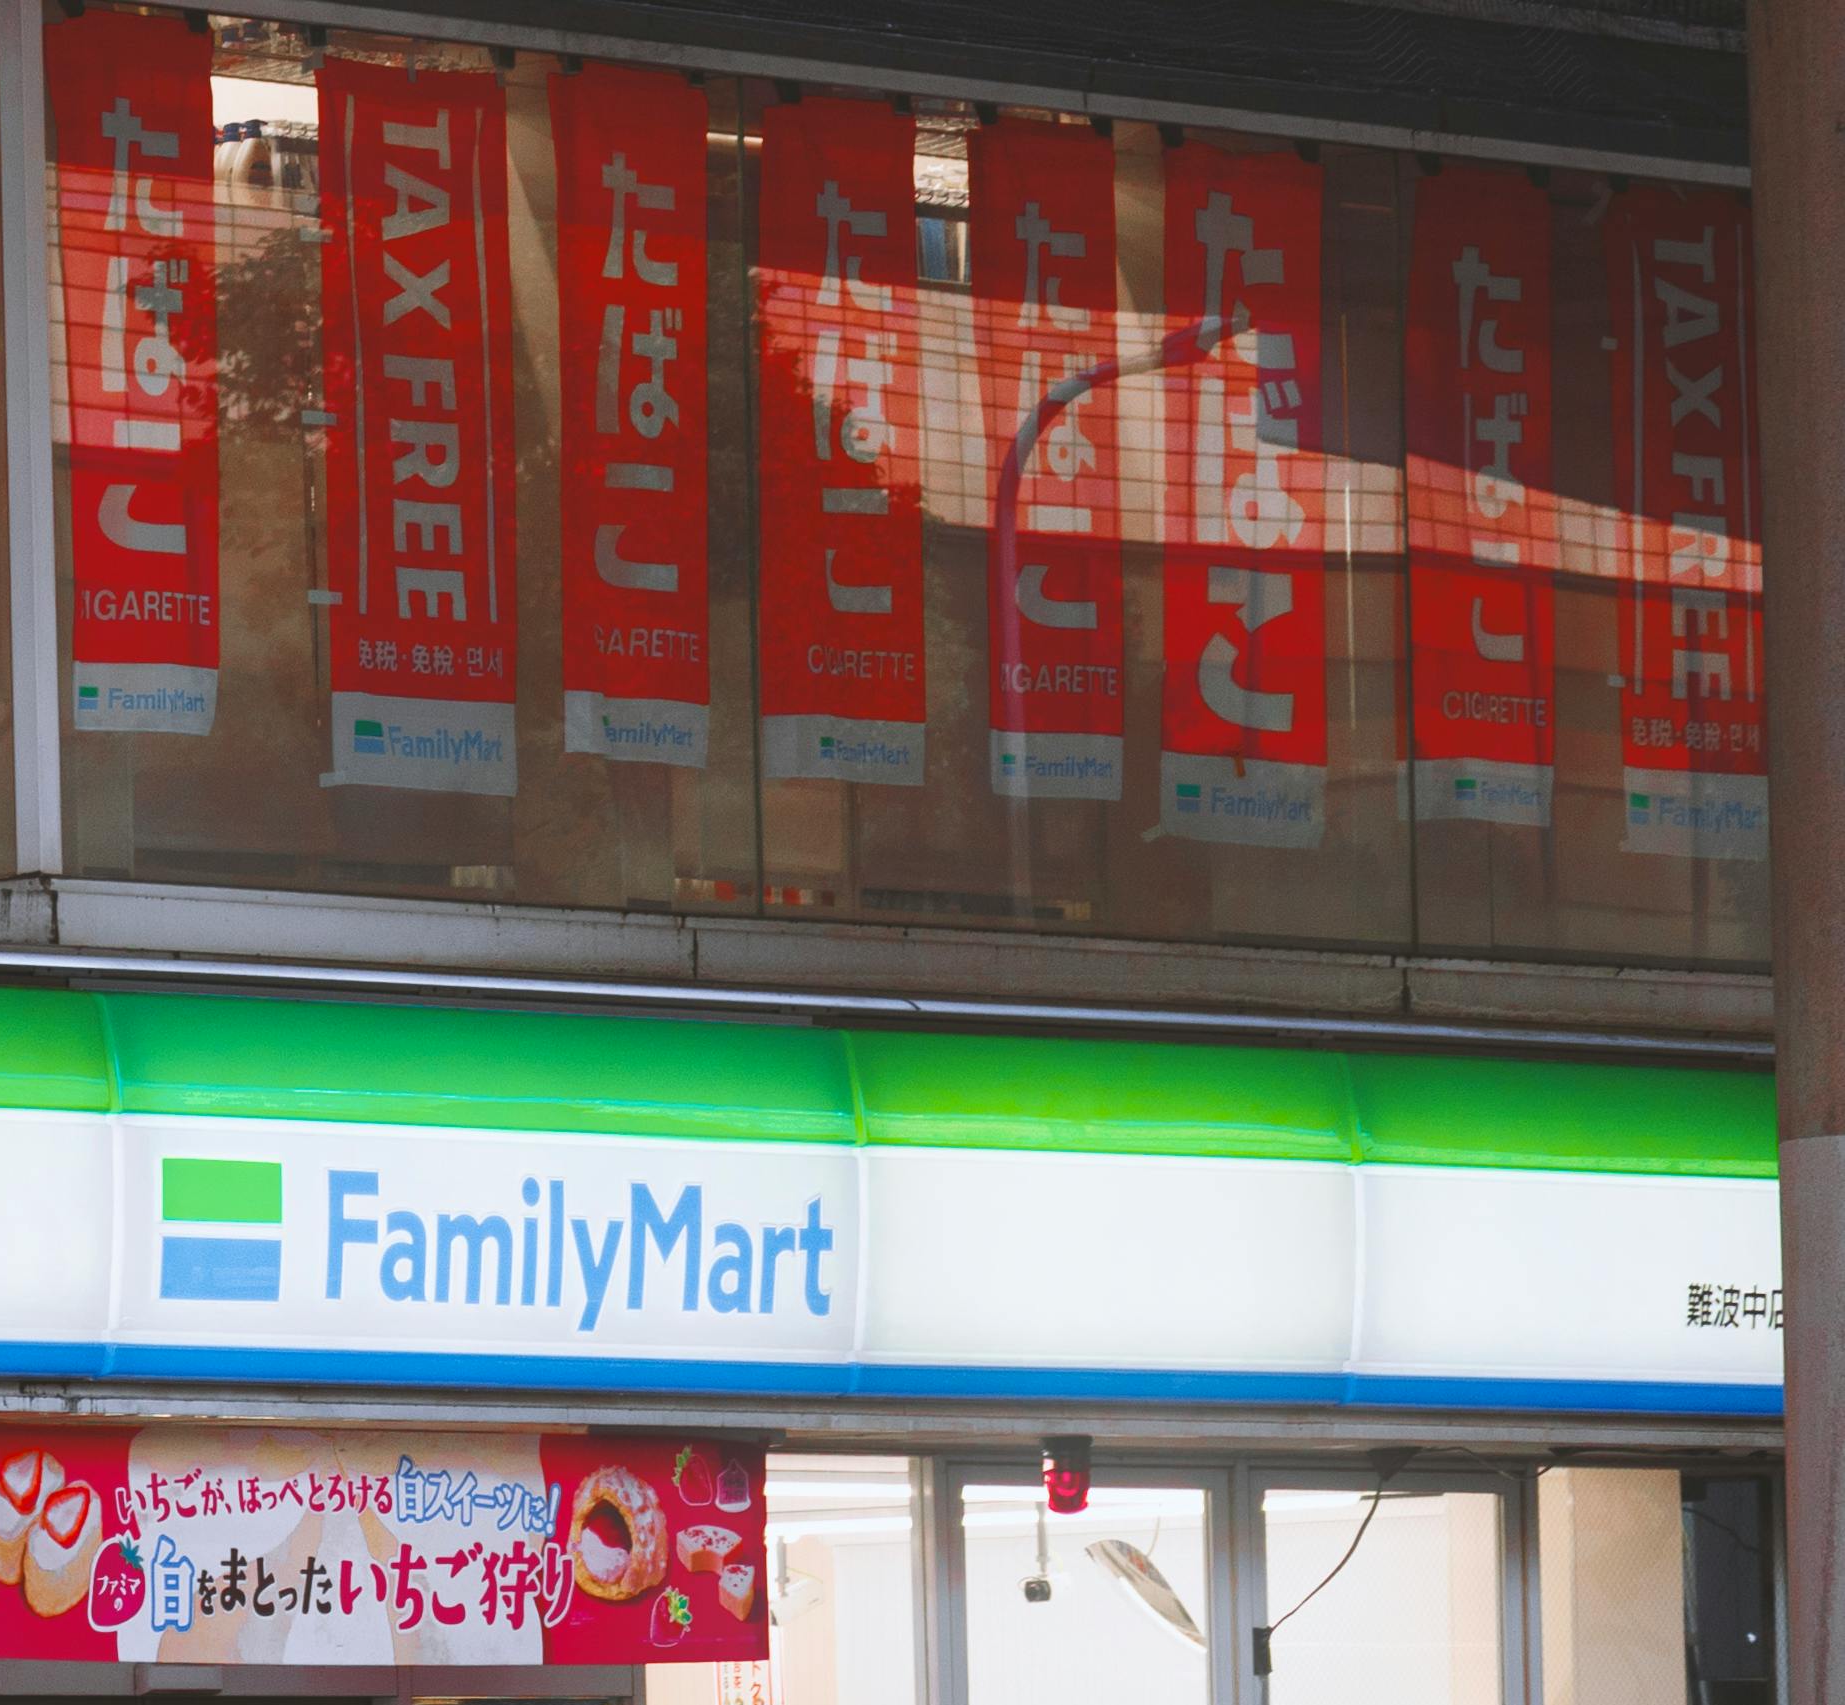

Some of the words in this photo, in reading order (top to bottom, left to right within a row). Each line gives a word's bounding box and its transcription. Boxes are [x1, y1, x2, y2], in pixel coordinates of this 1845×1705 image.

[98, 98, 189, 556] たばこ
[383, 109, 452, 331] TAX
[1654, 225, 1723, 429] TAX
[383, 355, 468, 623] FREE
[592, 152, 680, 593] たばこ
[815, 180, 897, 614] たばこ
[1015, 202, 1097, 629] たばこ
[1196, 191, 1305, 732] たばこ
[1453, 247, 1526, 663] たばこ
[81, 590, 210, 625] IGARETTE
[108, 687, 206, 713] FamilyMart
[1671, 452, 1732, 702] FREE
[325, 1168, 834, 1332] FamilyMart
[97, 1576, 141, 1596] ファミマ
